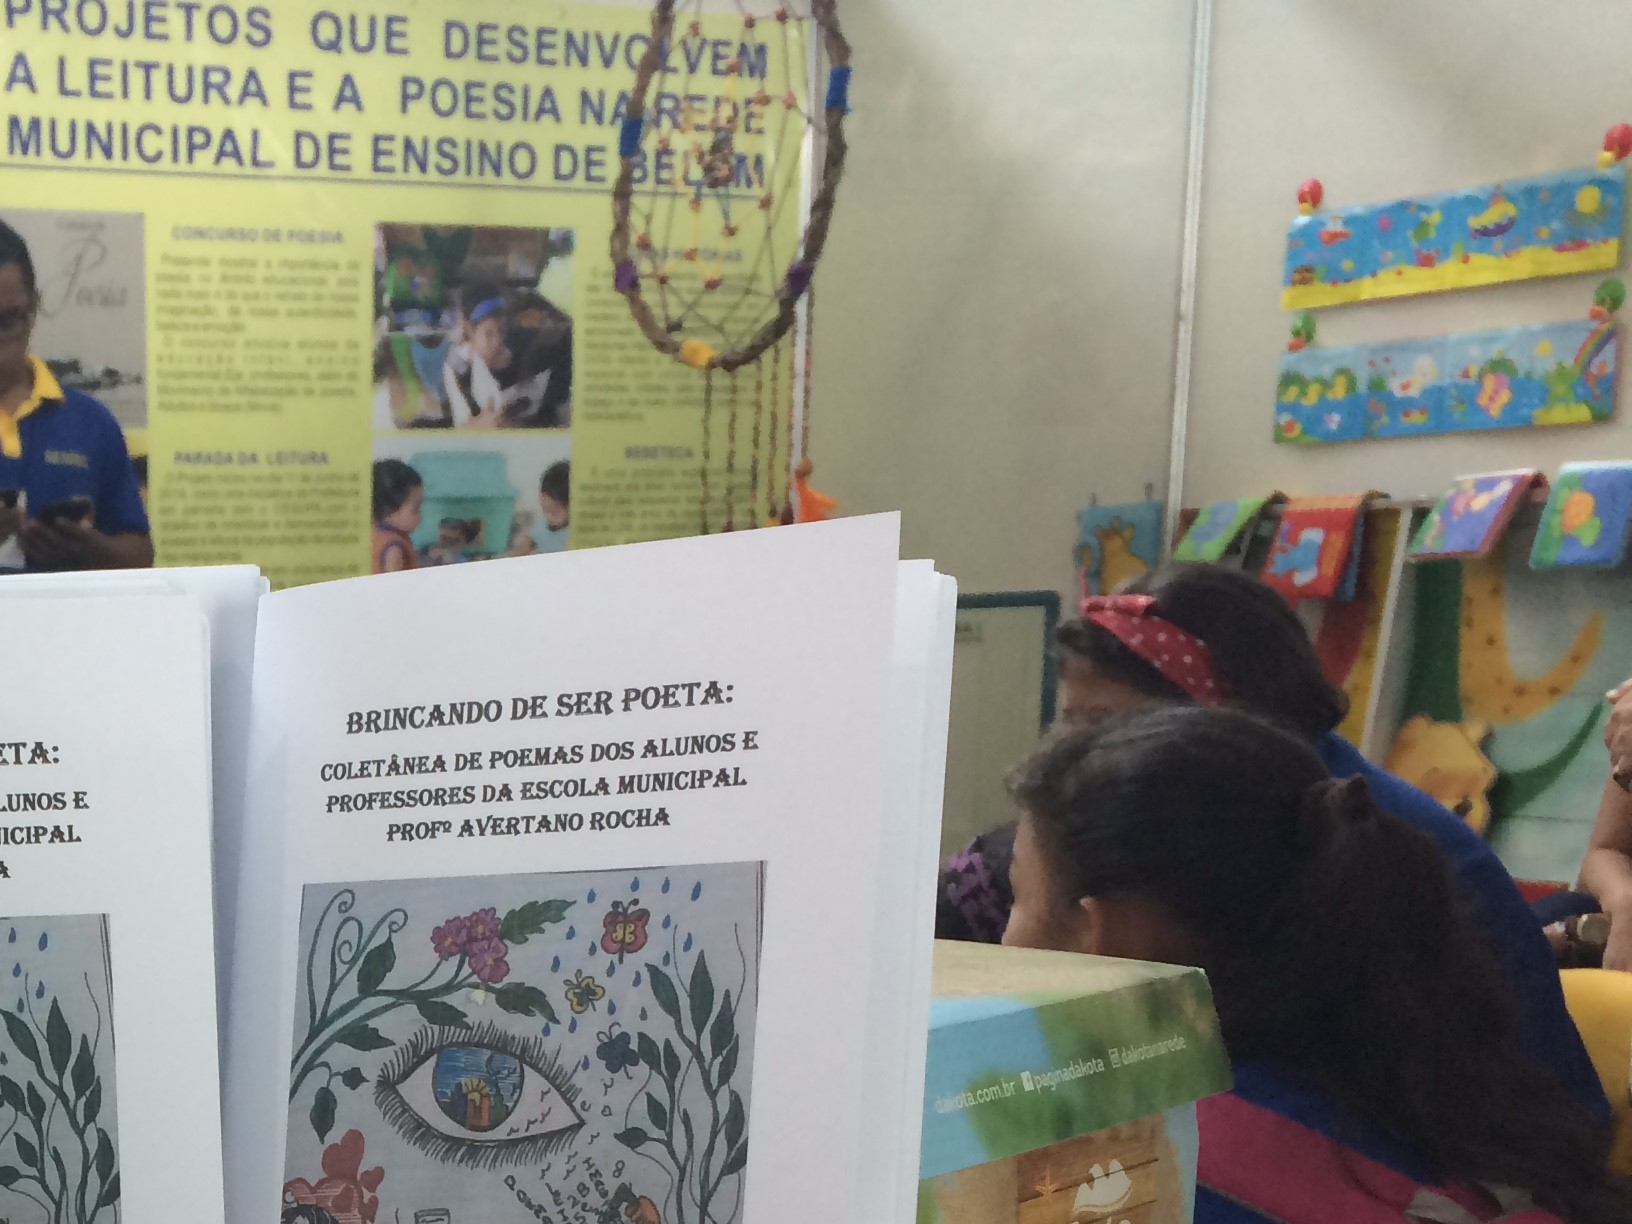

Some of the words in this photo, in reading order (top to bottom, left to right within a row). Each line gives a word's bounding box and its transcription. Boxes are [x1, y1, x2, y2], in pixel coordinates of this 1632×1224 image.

[4, 0, 272, 47] PROJETOS
[310, 11, 409, 55] QUE
[444, 19, 767, 79] DESENVOLVEM
[5, 51, 38, 94] A
[57, 55, 268, 106] LEITURA
[287, 69, 314, 110] E
[333, 73, 364, 113] A
[400, 76, 562, 124] POESIA
[579, 88, 635, 126] NA
[7, 114, 276, 168] MUNICIPAL
[294, 129, 352, 171] DE
[372, 133, 537, 180] ENSINO
[553, 143, 607, 184] DE
[346, 700, 502, 735] BRINCANDO
[510, 695, 548, 720] DE
[555, 691, 614, 717] SER
[621, 681, 734, 712] POETA:
[321, 754, 447, 782] COLETÂNEA
[454, 752, 483, 771] DE
[489, 745, 584, 769] POEMAS
[590, 741, 634, 762] DOS
[640, 733, 736, 758] ALUNOS
[742, 730, 759, 750] E
[72, 791, 90, 809] E
[326, 786, 475, 813] PROFESSORES
[482, 783, 513, 802] DA
[520, 777, 610, 800] ESCOLA
[616, 767, 747, 794] MUNICIPAL
[457, 813, 583, 837] AVERTANO
[589, 808, 670, 831] ROCHA
